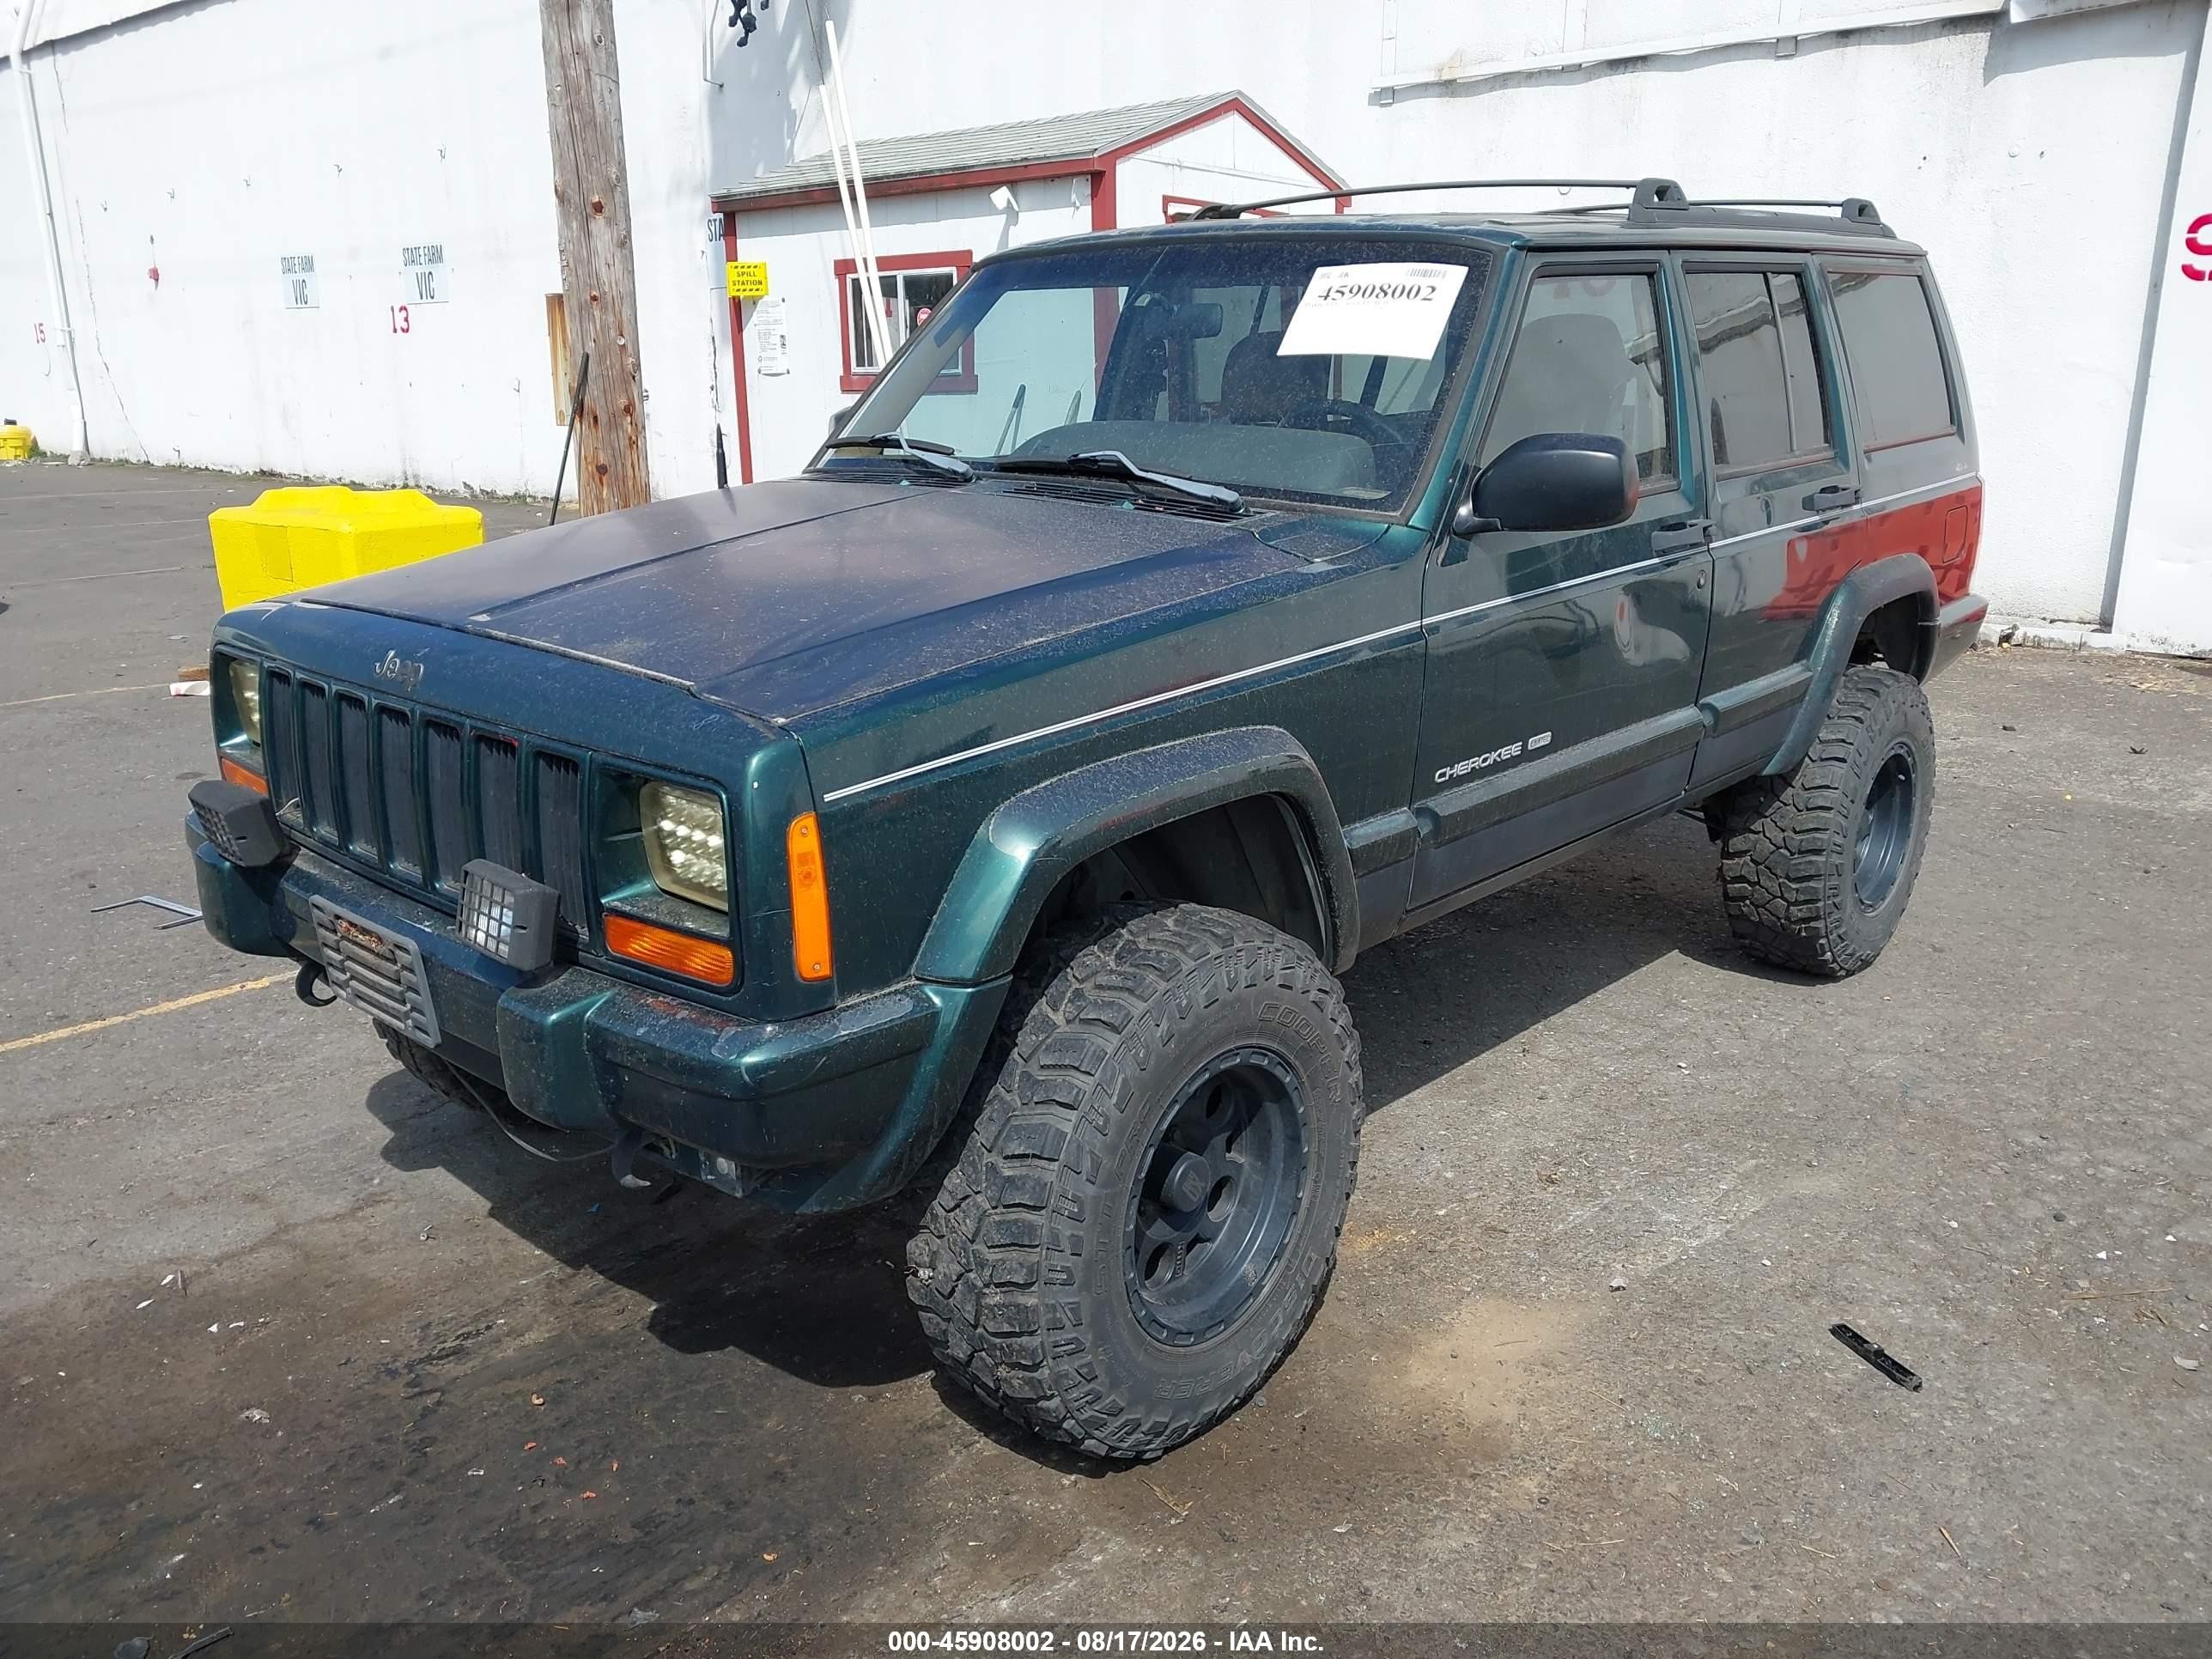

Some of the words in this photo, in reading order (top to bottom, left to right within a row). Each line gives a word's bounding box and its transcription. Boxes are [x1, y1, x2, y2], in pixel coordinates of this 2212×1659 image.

[281, 257, 297, 275] STATE
[298, 255, 315, 274] FARM
[403, 246, 422, 267] STATE
[423, 244, 444, 265] FARM
[292, 279, 308, 306] VIC
[416, 270, 435, 301] VIC
[1318, 283, 1437, 301] 45908002
[391, 305, 410, 334] 13
[34, 322, 46, 343] 15
[1435, 741, 1522, 783] CHEROKEE
